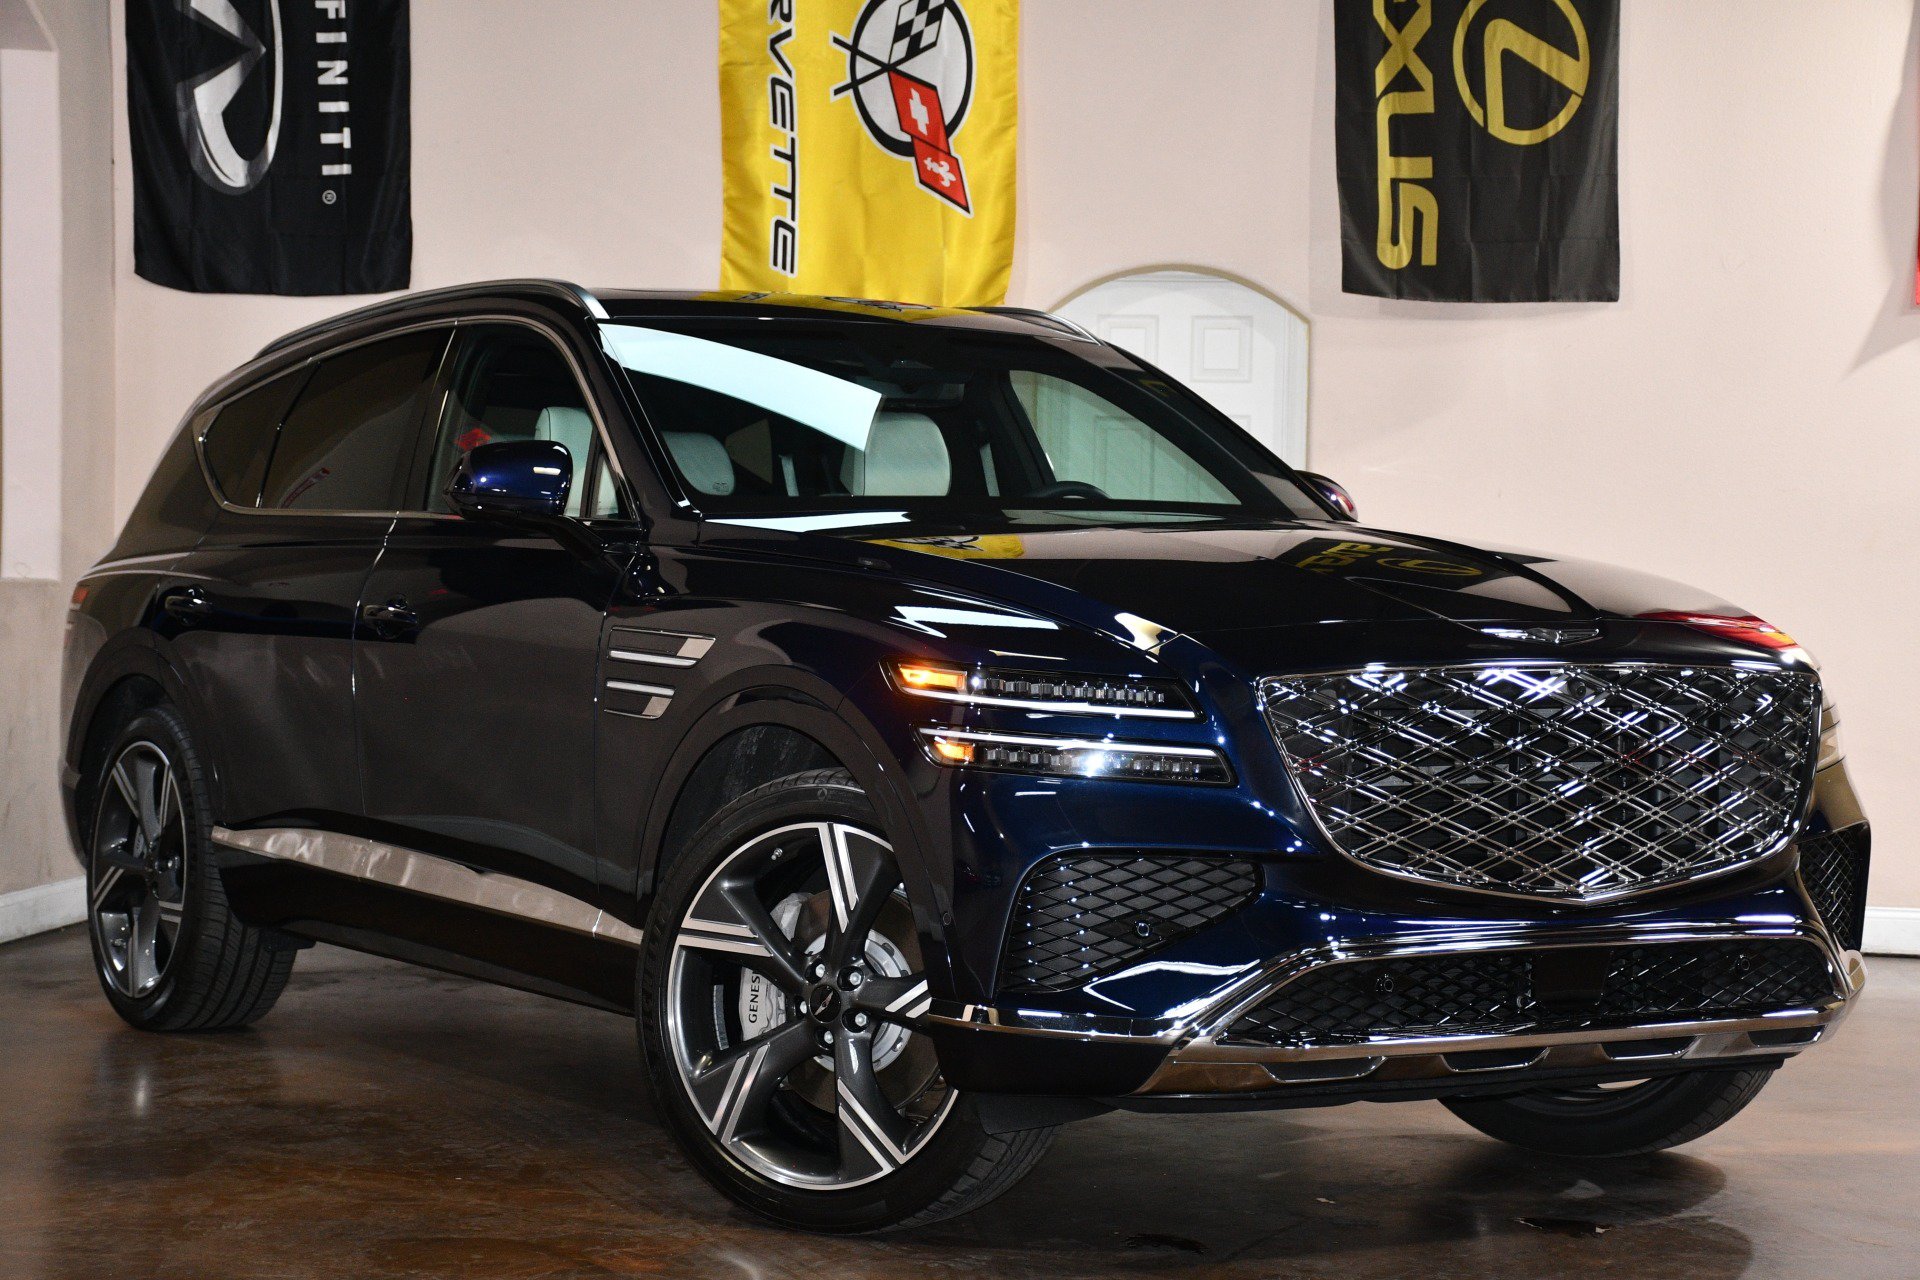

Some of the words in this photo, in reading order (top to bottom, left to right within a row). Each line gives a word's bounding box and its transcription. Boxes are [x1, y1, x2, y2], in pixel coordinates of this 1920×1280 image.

[315, 0, 351, 175] FINITI
[1373, 0, 1439, 270] XUS
[748, 972, 761, 1024] GENES
